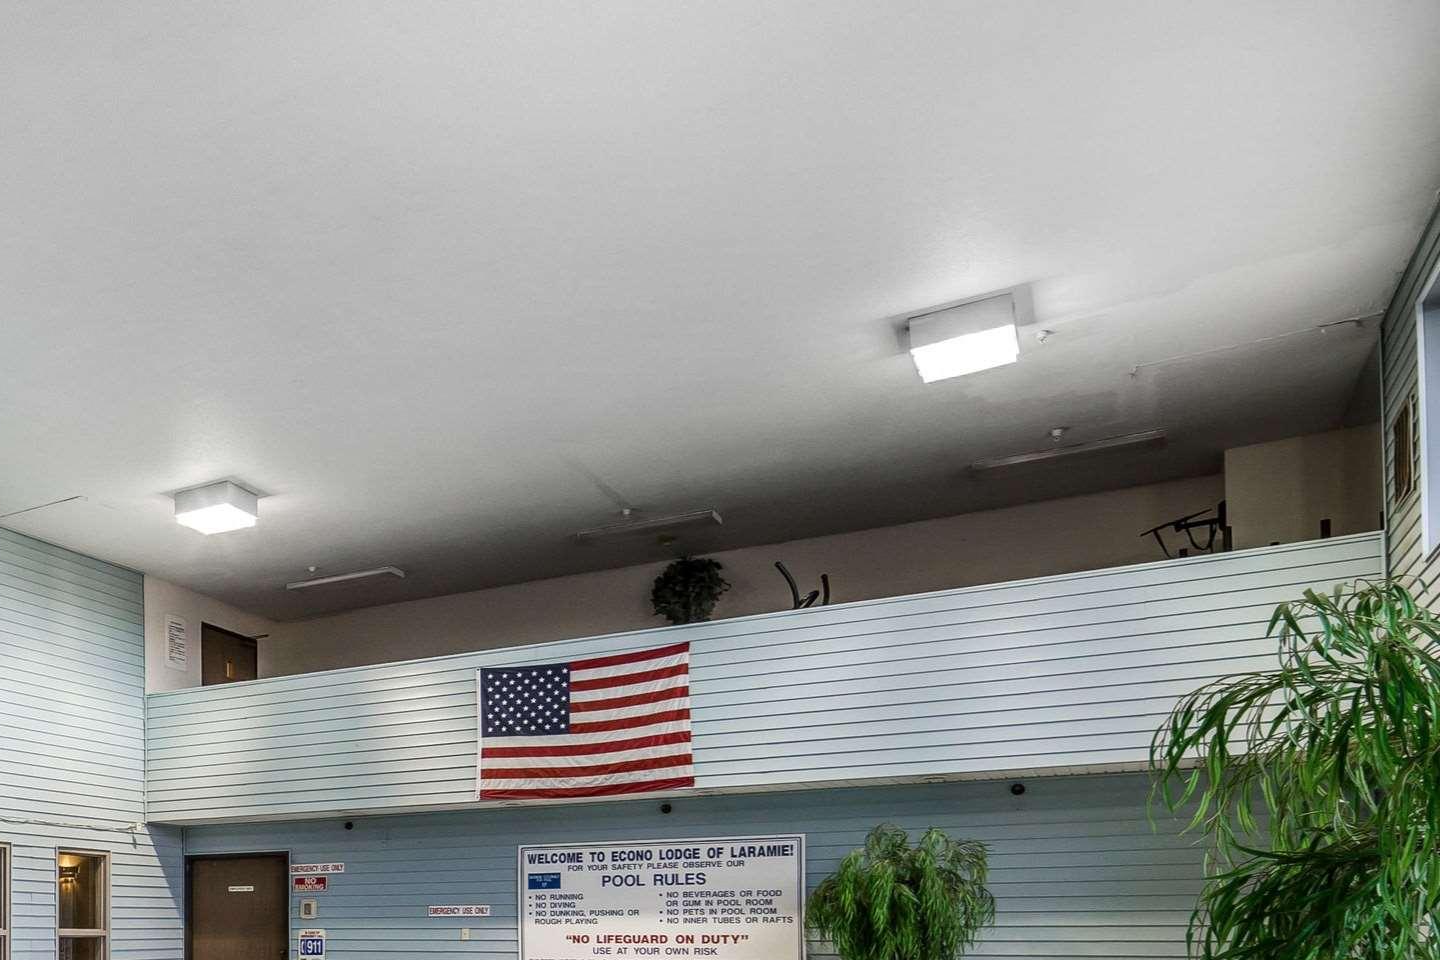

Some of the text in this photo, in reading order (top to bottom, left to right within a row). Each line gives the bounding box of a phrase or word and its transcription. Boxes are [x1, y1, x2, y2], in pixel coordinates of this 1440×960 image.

[527, 845, 794, 865] WELCOME TO ECONO LODGE OF LARAMIE!
[682, 860, 722, 868] OBSERVE
[304, 877, 317, 885] NO
[601, 872, 706, 887] POOL RULES
[682, 890, 735, 898] BEVERAGES
[550, 901, 576, 909] DIVING
[762, 916, 793, 924] RAFTS
[596, 934, 668, 944] LIFEGUARD
[675, 934, 695, 944] ON
[306, 940, 321, 954] 911
[593, 947, 718, 955] USE AT YOUR OWN RISK
